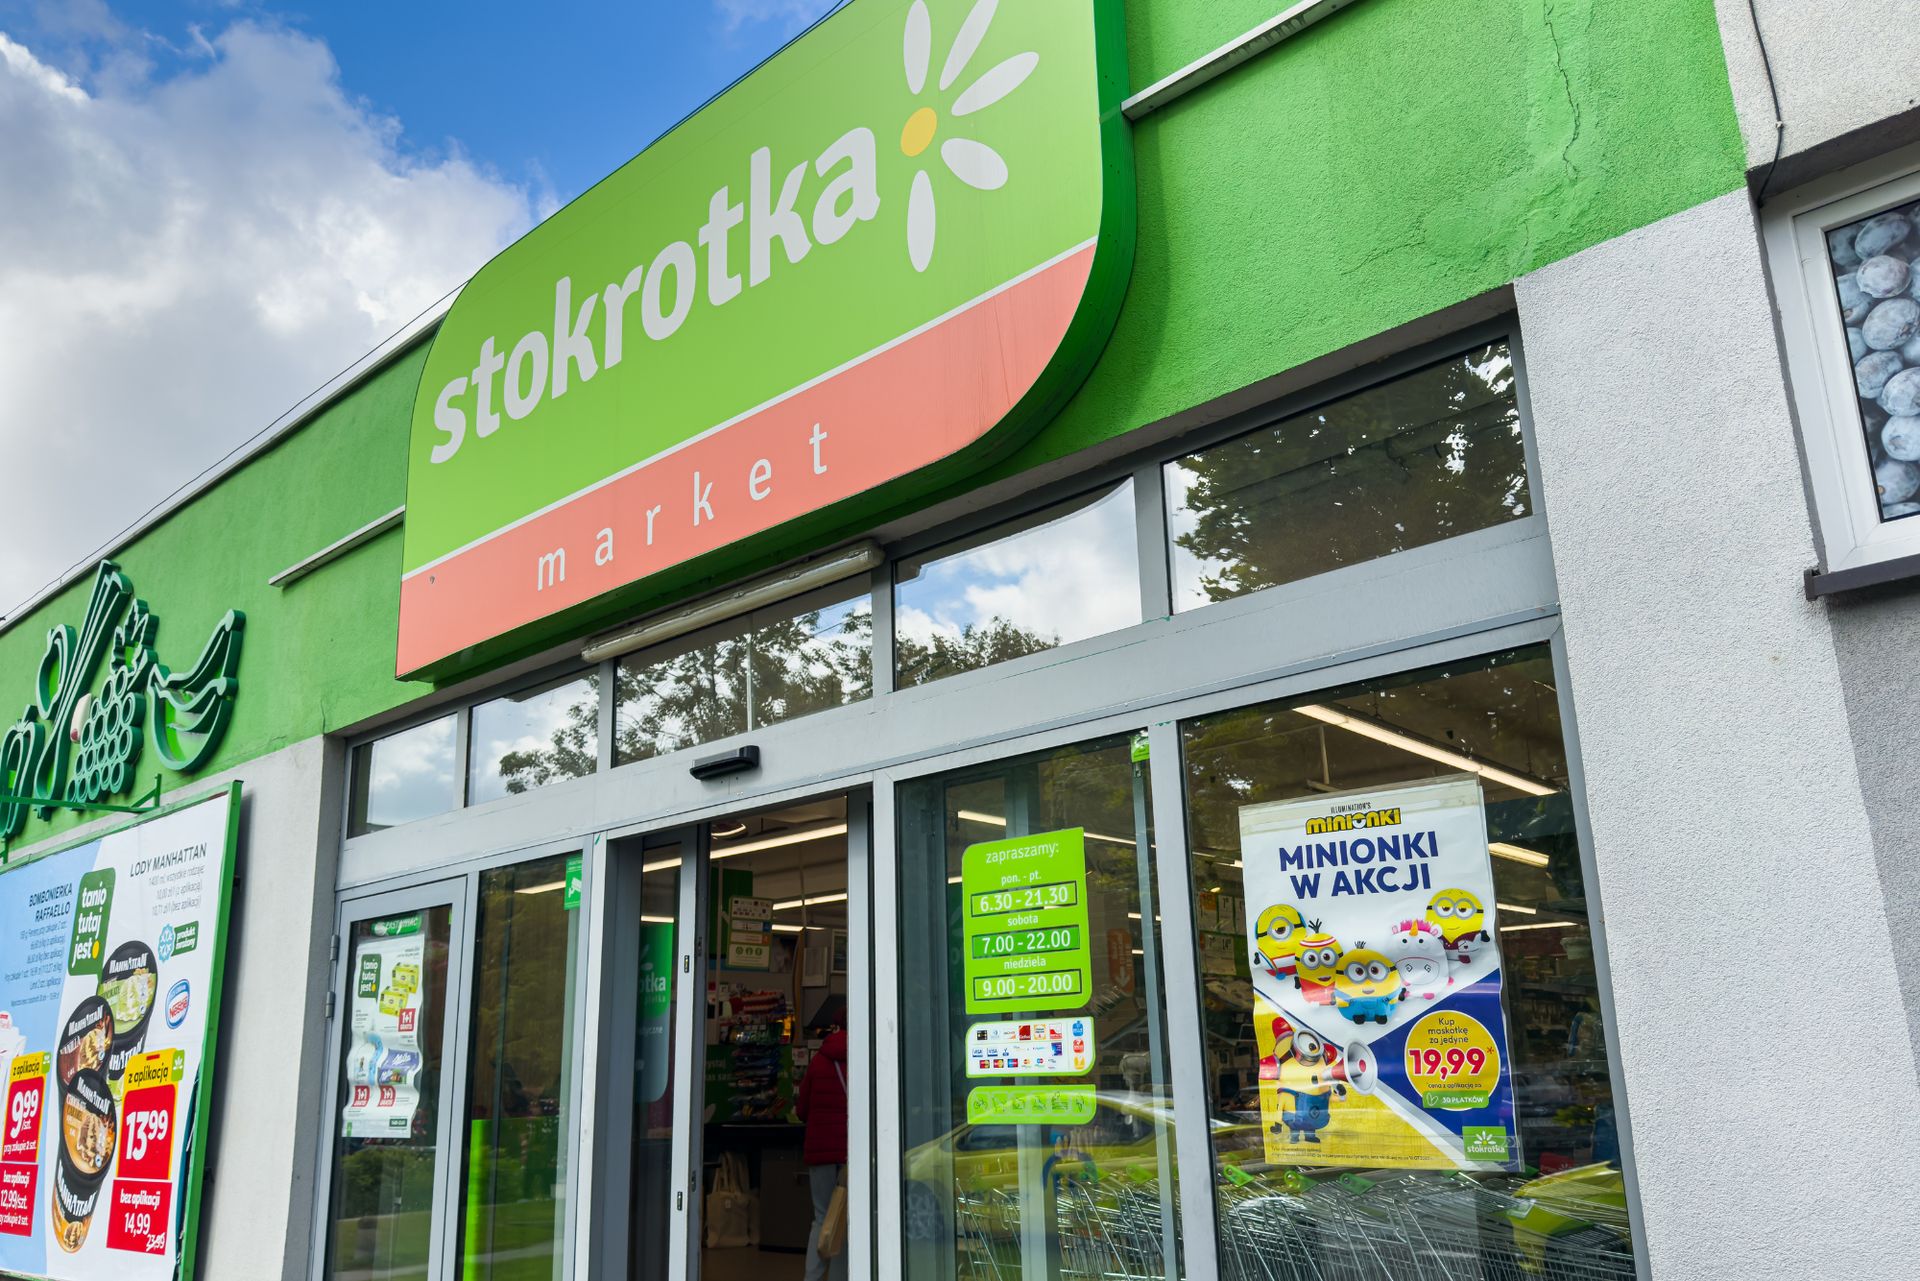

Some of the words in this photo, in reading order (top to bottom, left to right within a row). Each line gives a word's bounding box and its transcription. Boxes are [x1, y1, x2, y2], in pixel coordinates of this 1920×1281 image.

[430, 126, 881, 464] stokrotka
[537, 422, 828, 591] market
[1330, 802, 1371, 814] ILLUMINATION'S
[130, 858, 152, 877] LODY
[152, 842, 207, 871] MANHATTAN
[986, 842, 1059, 864] zapraszamy:
[1279, 831, 1438, 872] MINIONKI
[1001, 874, 1020, 886] pon.
[1030, 870, 1041, 882] pt.
[1290, 873, 1320, 899] W
[1331, 863, 1431, 896] AKCJI
[29, 882, 73, 907] BOMBONIERKA
[82, 881, 107, 908] tanio
[980, 893, 1012, 912] 6.30
[1025, 886, 1069, 907] 21.30
[35, 901, 70, 922] RAFFAELLO
[78, 906, 102, 939] tutaj
[1007, 915, 1038, 926] sobota
[982, 935, 1014, 954] 7.00
[1027, 929, 1071, 950] 22.00
[1004, 956, 1046, 969] niedziela
[983, 978, 1015, 996] 9.00
[1028, 974, 1072, 993] 20.00
[1428, 1027, 1468, 1035] maskotkę
[1438, 1018, 1455, 1026] Kup
[1440, 1036, 1468, 1045] jedyne
[13, 1066, 17, 1076] z
[128, 1073, 133, 1083] z
[134, 1063, 169, 1087] aplikacją
[1467, 1145, 1505, 1153] stokrotka
[120, 1188, 132, 1204] bez
[132, 1190, 161, 1211] aplikacji
[124, 1212, 151, 1237] 14,99
